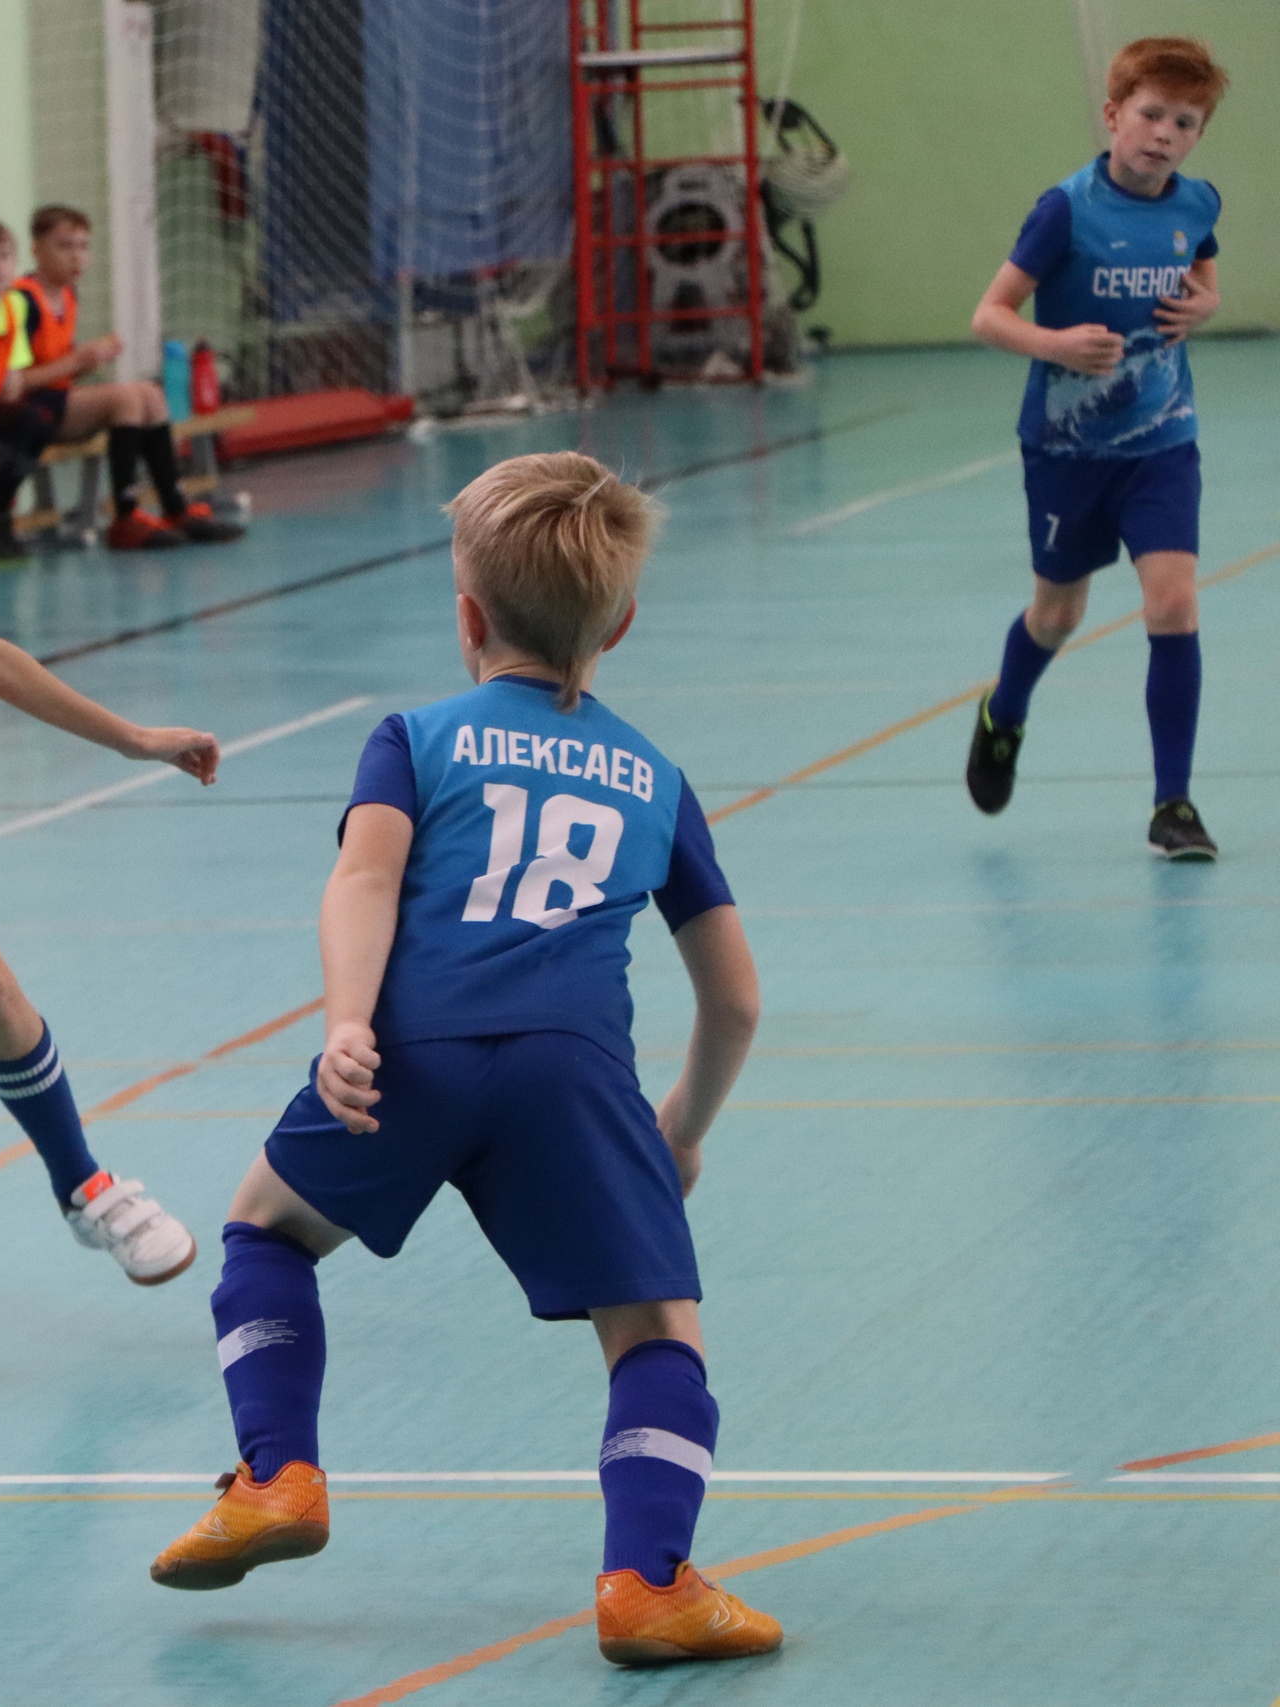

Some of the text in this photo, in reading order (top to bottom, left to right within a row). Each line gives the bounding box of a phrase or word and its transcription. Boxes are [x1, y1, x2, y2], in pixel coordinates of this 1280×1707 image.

[1045, 512, 1061, 551] 7
[453, 725, 654, 803] АЛЕКСАЕВ
[461, 782, 625, 930] 18
